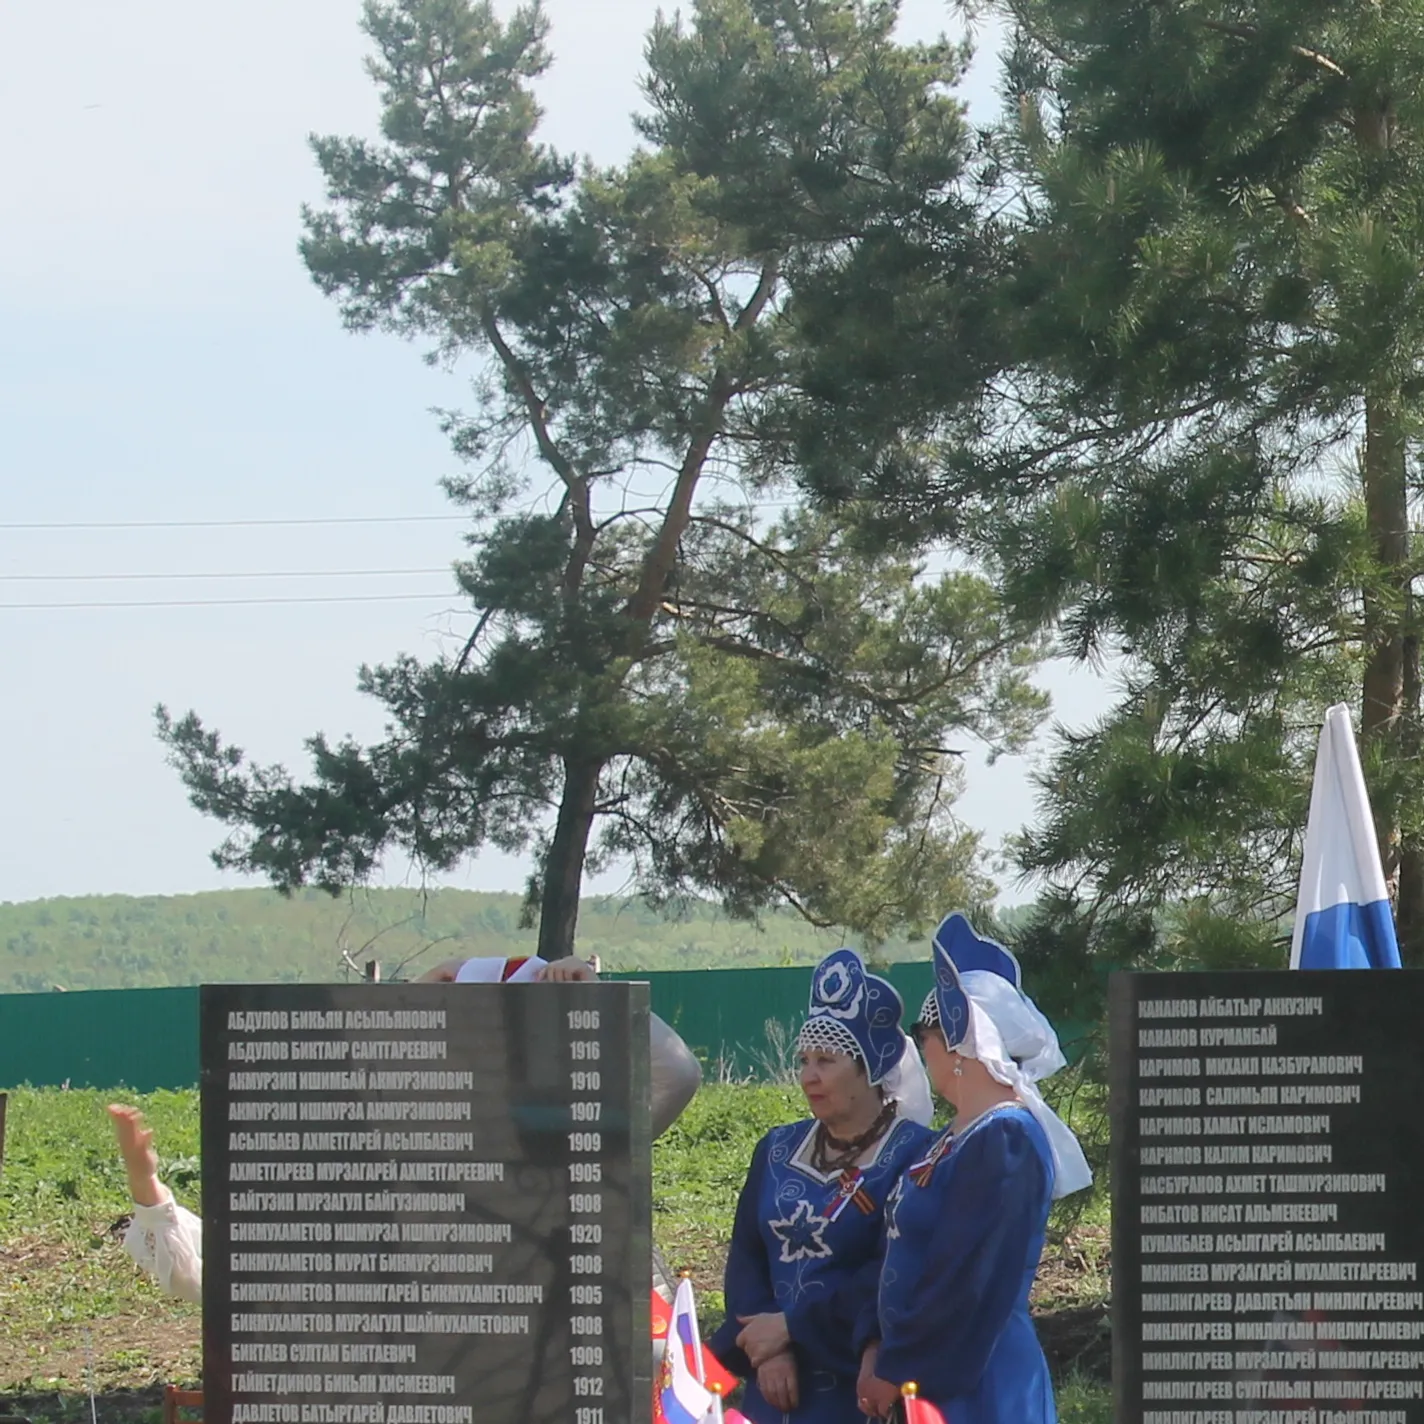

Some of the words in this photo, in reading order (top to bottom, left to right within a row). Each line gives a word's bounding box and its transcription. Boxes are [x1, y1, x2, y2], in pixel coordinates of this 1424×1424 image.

[568, 1010, 600, 1029] 1906
[570, 1041, 599, 1060] 1916
[569, 1194, 601, 1212] 1908
[571, 1346, 603, 1365] 1909
